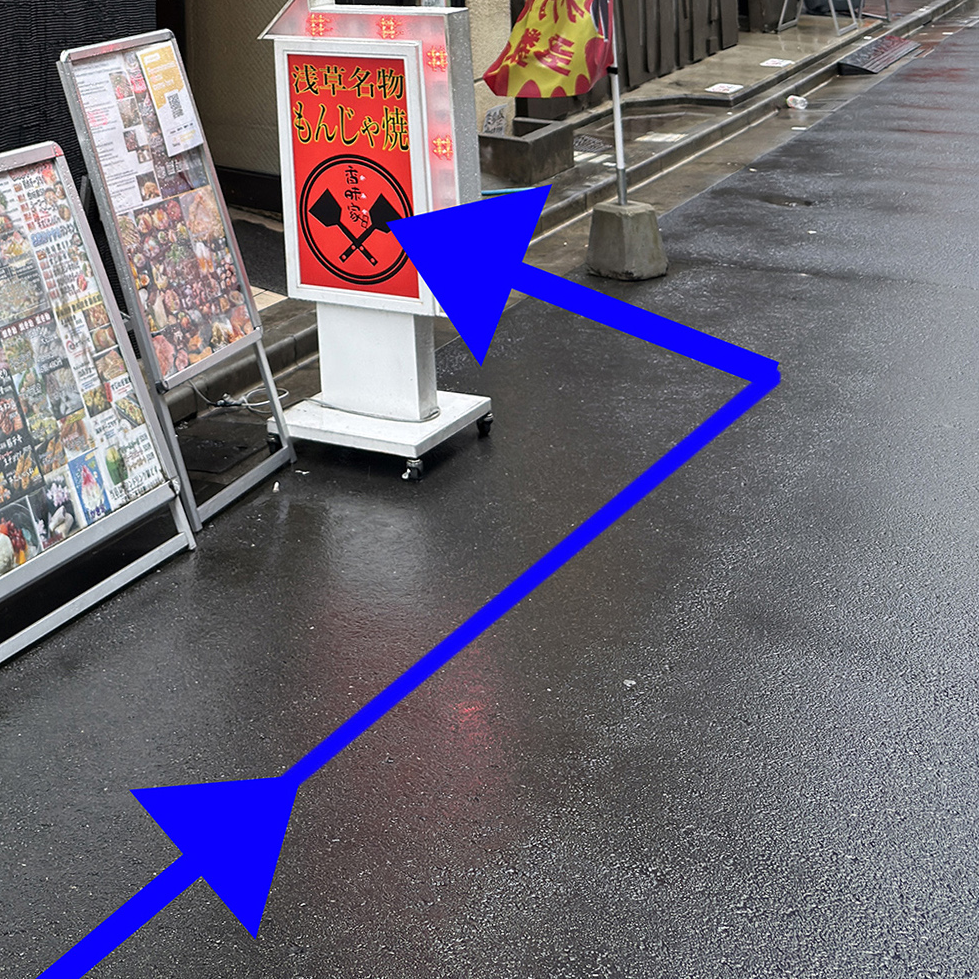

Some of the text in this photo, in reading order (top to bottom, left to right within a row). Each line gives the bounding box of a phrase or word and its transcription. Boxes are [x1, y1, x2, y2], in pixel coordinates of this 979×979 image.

[292, 64, 405, 101] 浅草名物
[292, 101, 410, 152] もんじゃ焼
[344, 165, 364, 223] 香味家
